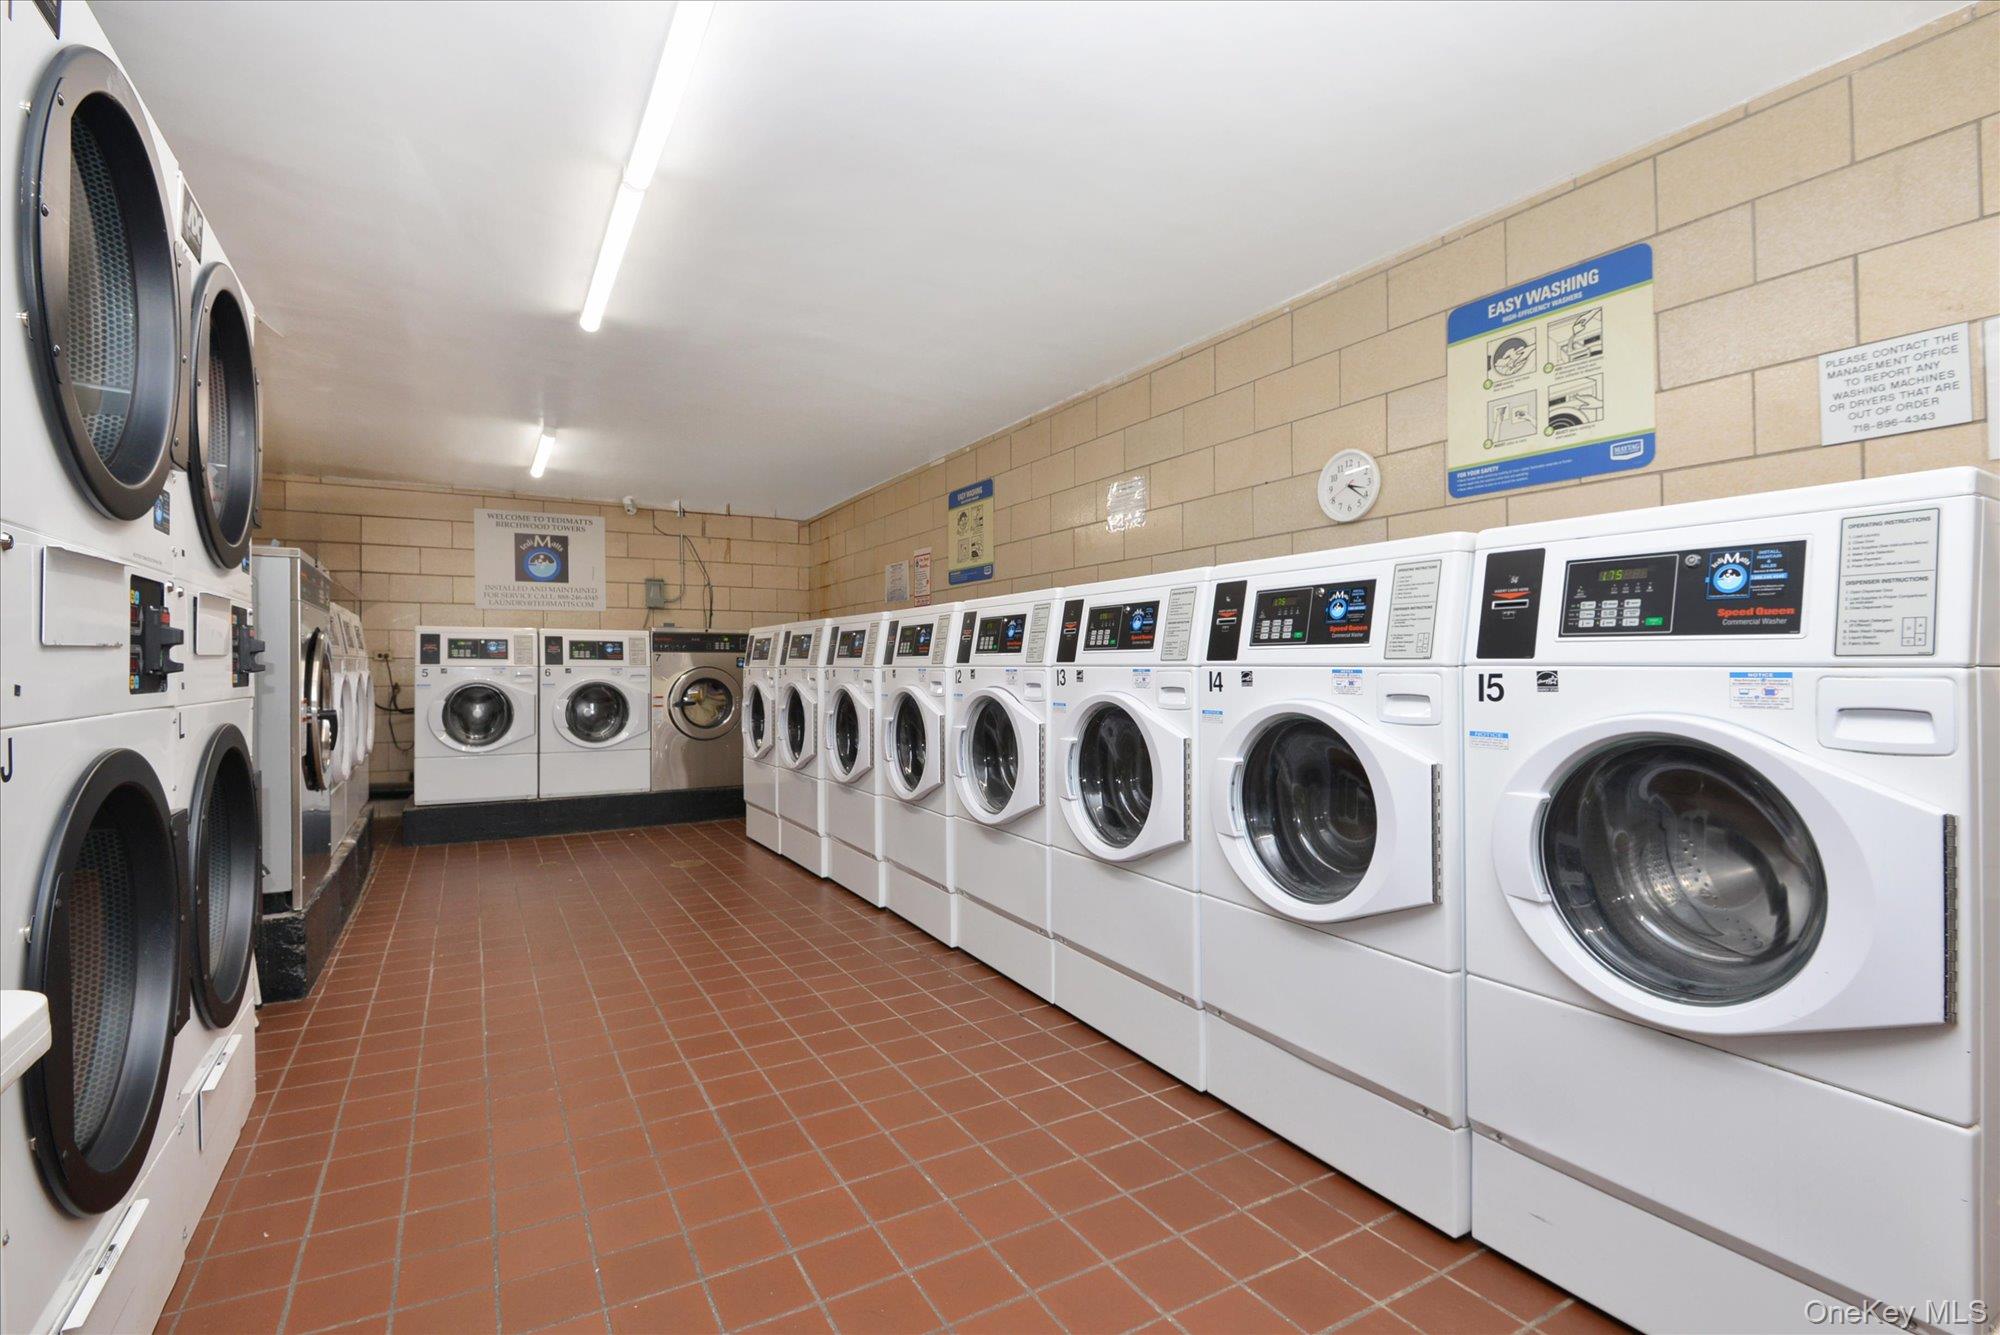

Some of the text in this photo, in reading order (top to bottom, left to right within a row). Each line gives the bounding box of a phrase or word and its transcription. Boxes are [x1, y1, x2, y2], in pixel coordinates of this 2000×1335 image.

[1488, 268, 1599, 318] EASY WASHING
[1552, 292, 1582, 306] WASHERS
[1825, 332, 1960, 368] PLEASE CONTACT THE
[1827, 344, 1960, 379] MANAGEMENT OFFICE
[1833, 370, 1956, 400] WASHING MACHINES
[1845, 360, 1941, 387] TO REPORT ANY
[1829, 381, 1960, 413] OR DRYERS THAT ARE
[1848, 397, 1940, 420] OUT OF ORDER
[487, 513, 530, 522] WELCOME
[546, 517, 593, 526] TEDIMATTS
[496, 521, 550, 530] BIRCHWOOD
[1848, 516, 1931, 529] OPERATING INSTRUCTIONS
[1718, 607, 1795, 618] Speed Queen
[422, 668, 428, 678] 5
[545, 668, 551, 677] 6
[1056, 669, 1066, 686] 13
[1209, 671, 1223, 692] 14
[1478, 673, 1505, 702] 15
[179, 712, 185, 739] L
[0, 738, 12, 782] J
